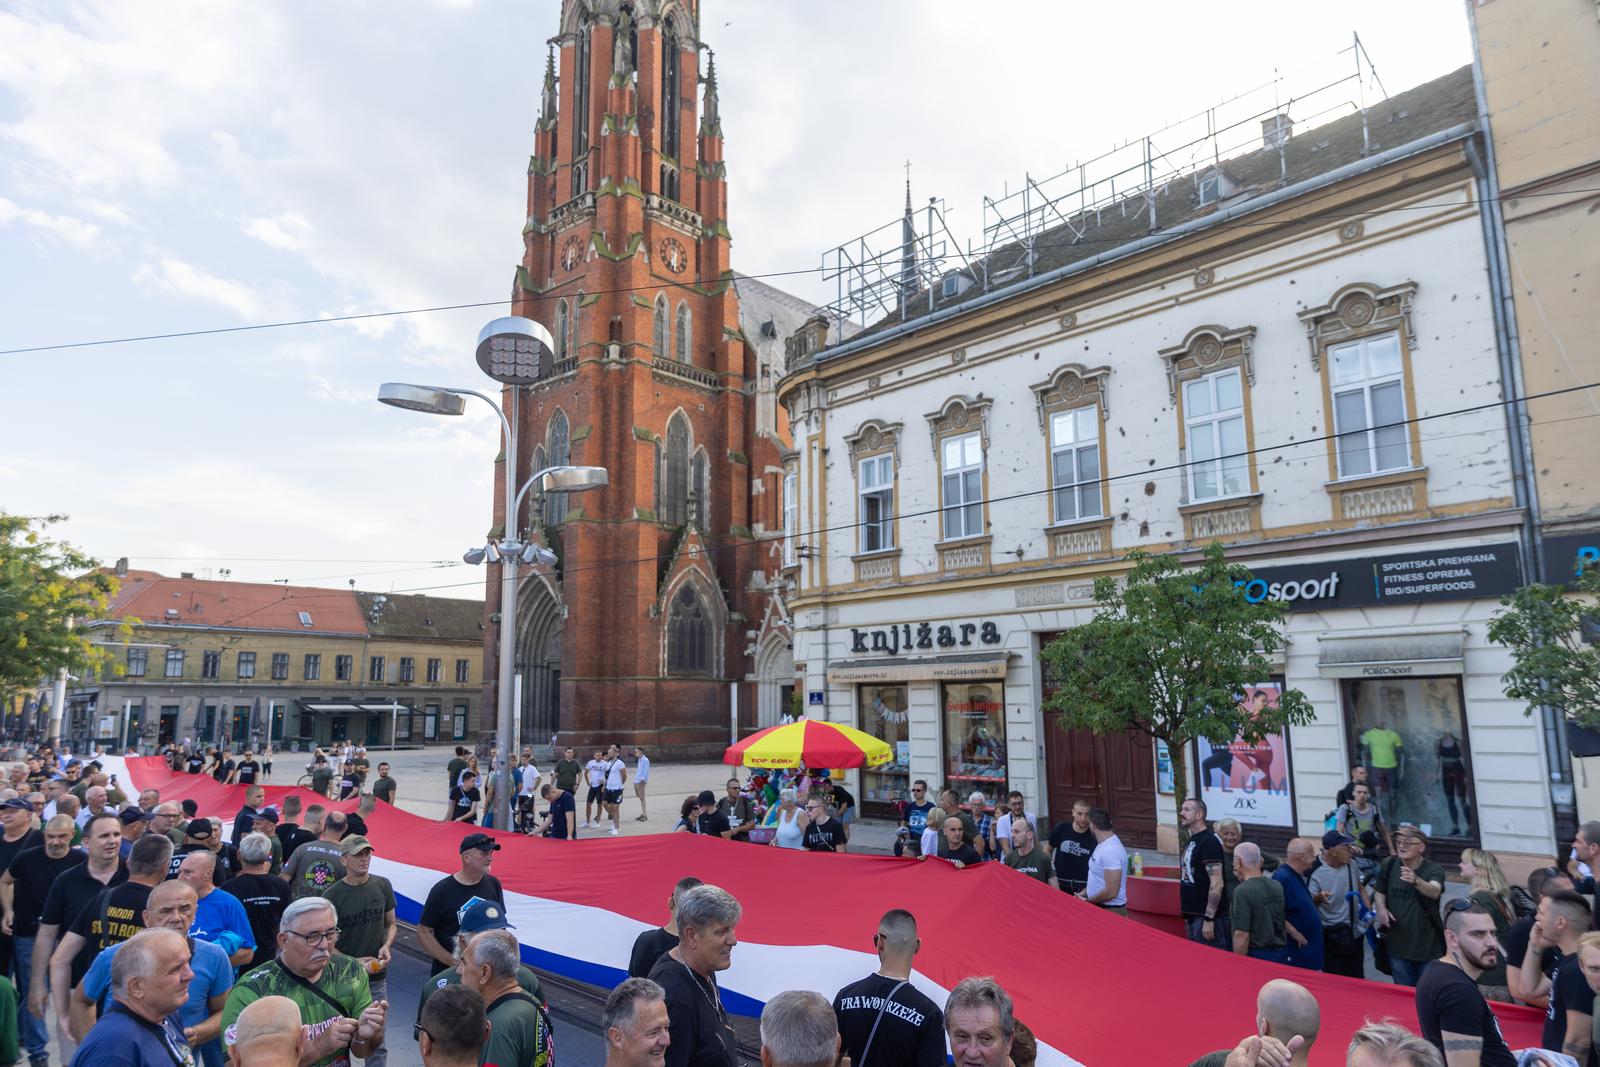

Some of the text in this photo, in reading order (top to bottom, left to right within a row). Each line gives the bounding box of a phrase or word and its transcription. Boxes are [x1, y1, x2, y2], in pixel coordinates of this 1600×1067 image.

[1382, 553, 1496, 572] SPORTSKA PREHRANA
[1383, 568, 1472, 583] FITNESS OPREMA
[1384, 580, 1476, 596] BIO/SUPERFOODS
[851, 621, 1001, 656] knjižara
[840, 995, 926, 1028] PRAWORZEŻE
